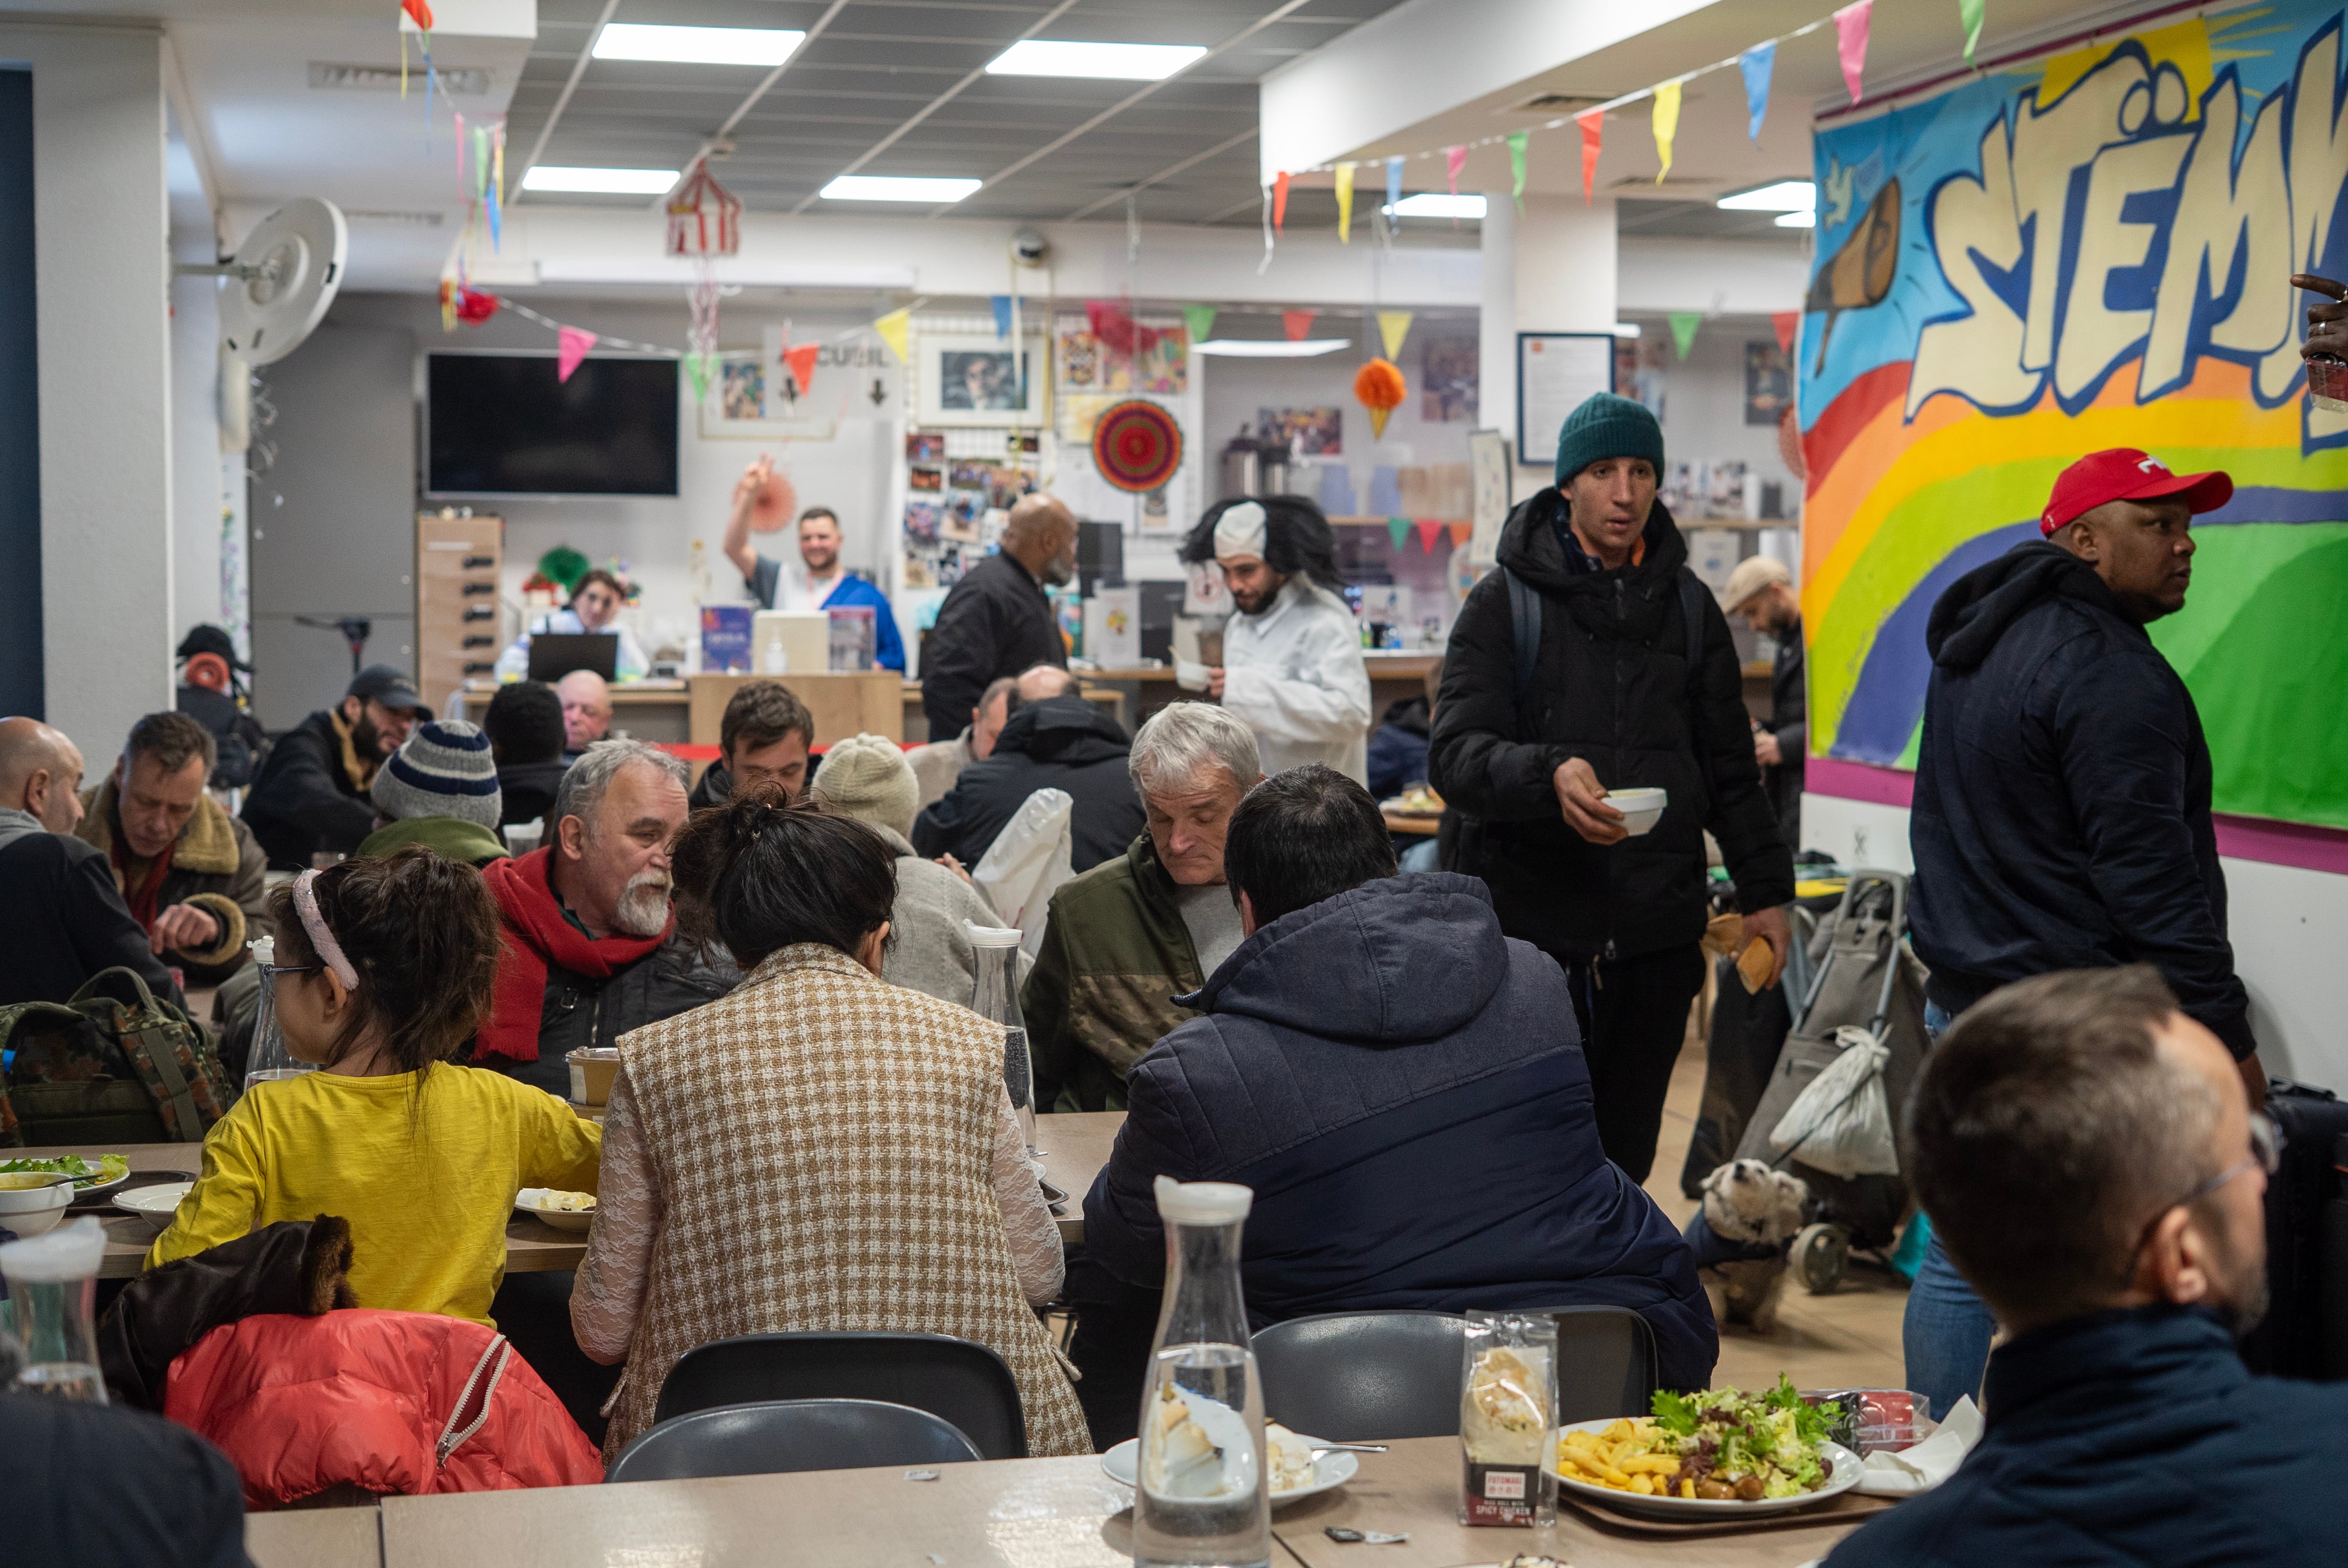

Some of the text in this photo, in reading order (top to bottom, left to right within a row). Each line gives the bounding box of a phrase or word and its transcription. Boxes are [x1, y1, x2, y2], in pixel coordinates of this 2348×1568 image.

[777, 344, 891, 368] CUEIL
[1476, 1505, 1531, 1516] SPICY CHICKEN
